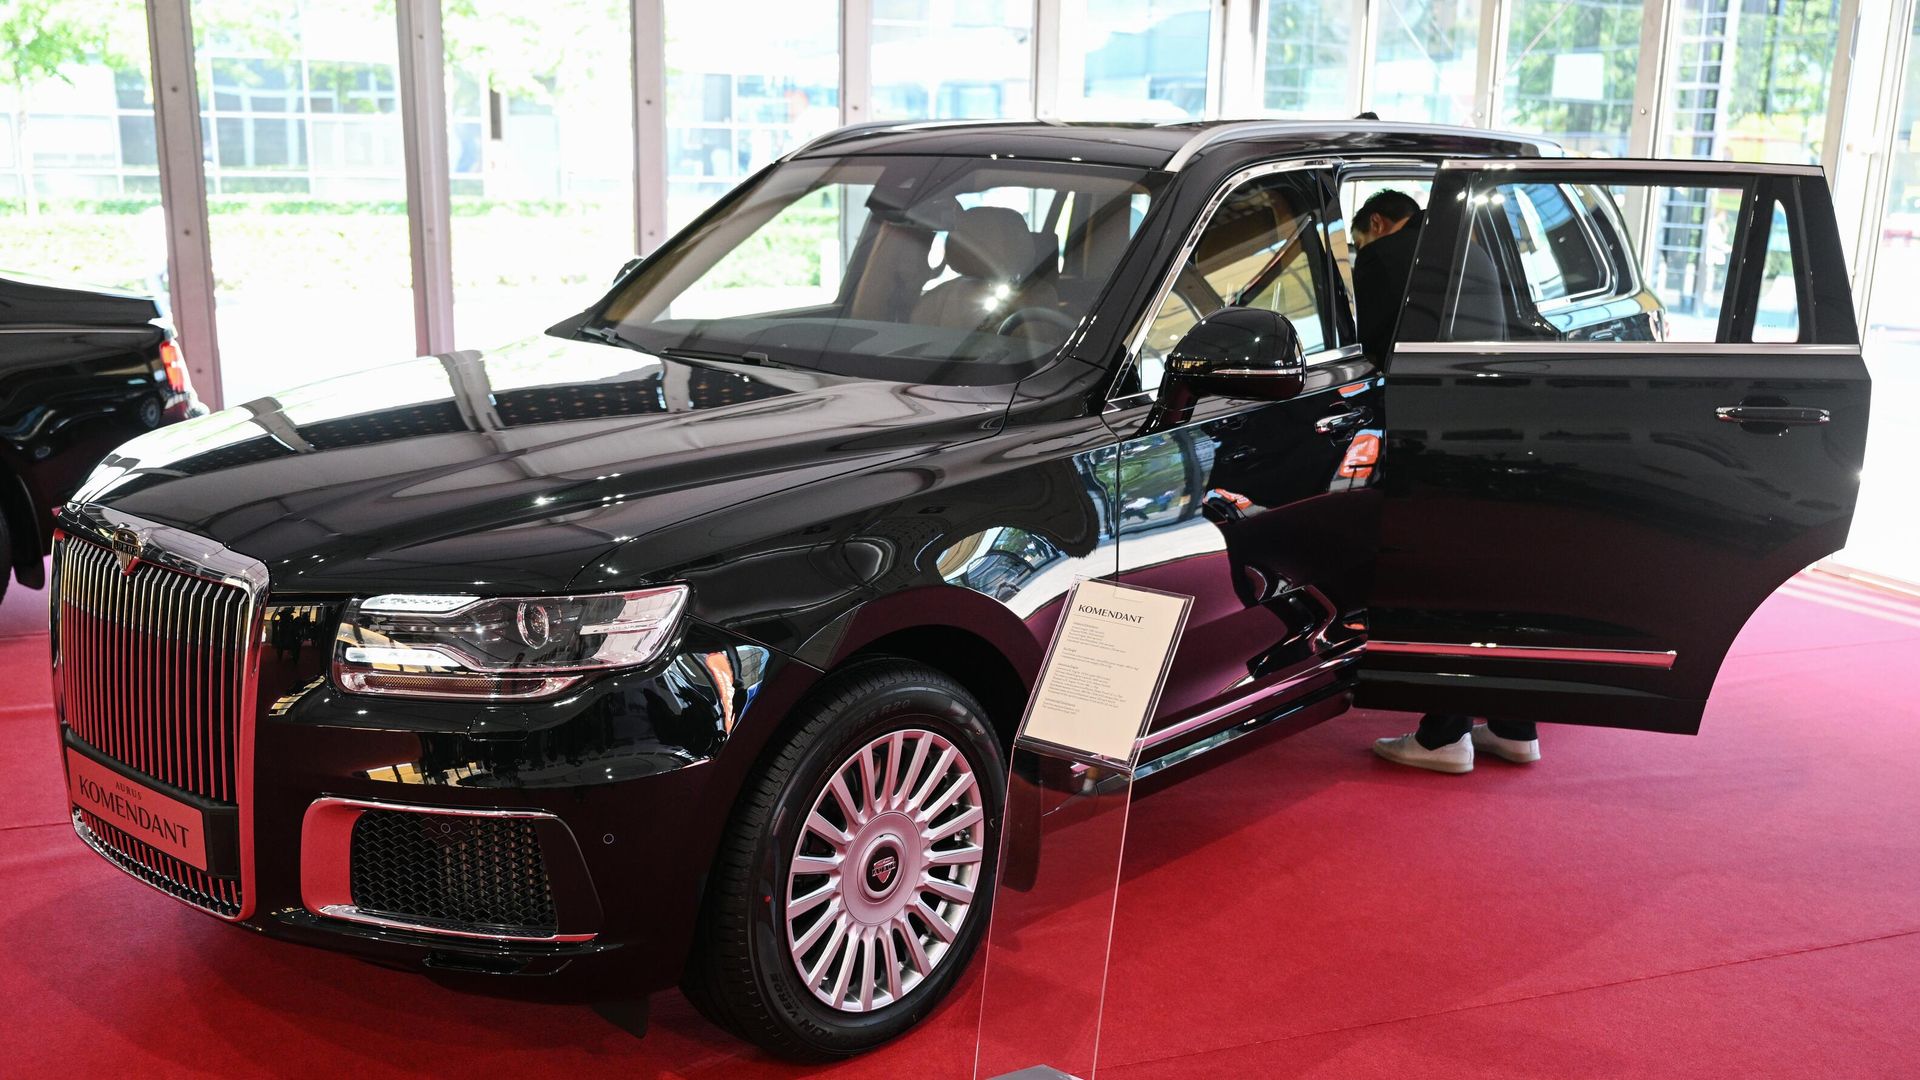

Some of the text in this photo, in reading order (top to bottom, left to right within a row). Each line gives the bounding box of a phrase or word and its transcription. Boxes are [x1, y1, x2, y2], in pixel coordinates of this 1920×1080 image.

[1078, 604, 1144, 624] KOMENDANT
[115, 782, 142, 800] AURUS
[79, 775, 189, 848] KOMENDANT
[769, 973, 798, 1018] VERDE
